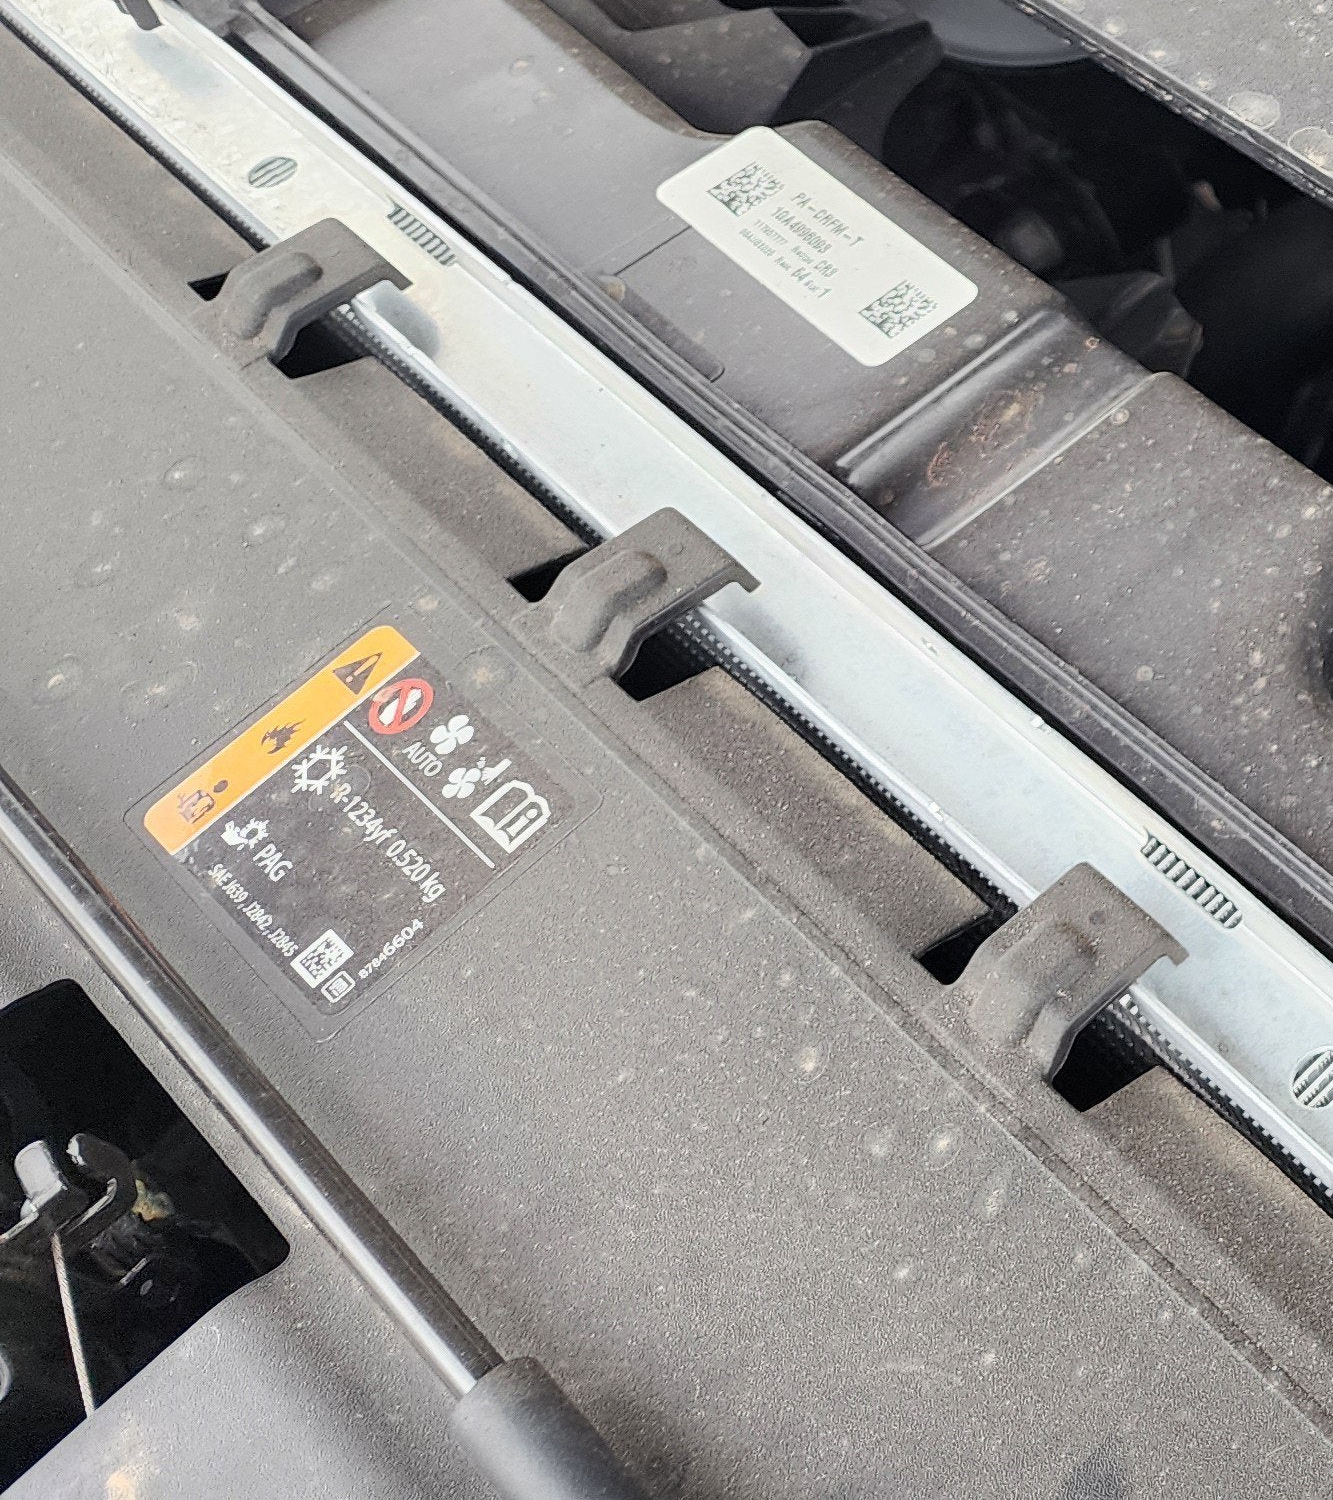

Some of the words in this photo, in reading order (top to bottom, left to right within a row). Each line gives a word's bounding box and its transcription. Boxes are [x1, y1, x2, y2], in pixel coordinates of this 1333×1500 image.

[402, 741, 443, 777] AUTO
[330, 782, 397, 845] R-1234yf
[385, 840, 430, 884] 0.520
[420, 872, 446, 903] kg
[253, 844, 294, 882] PAG
